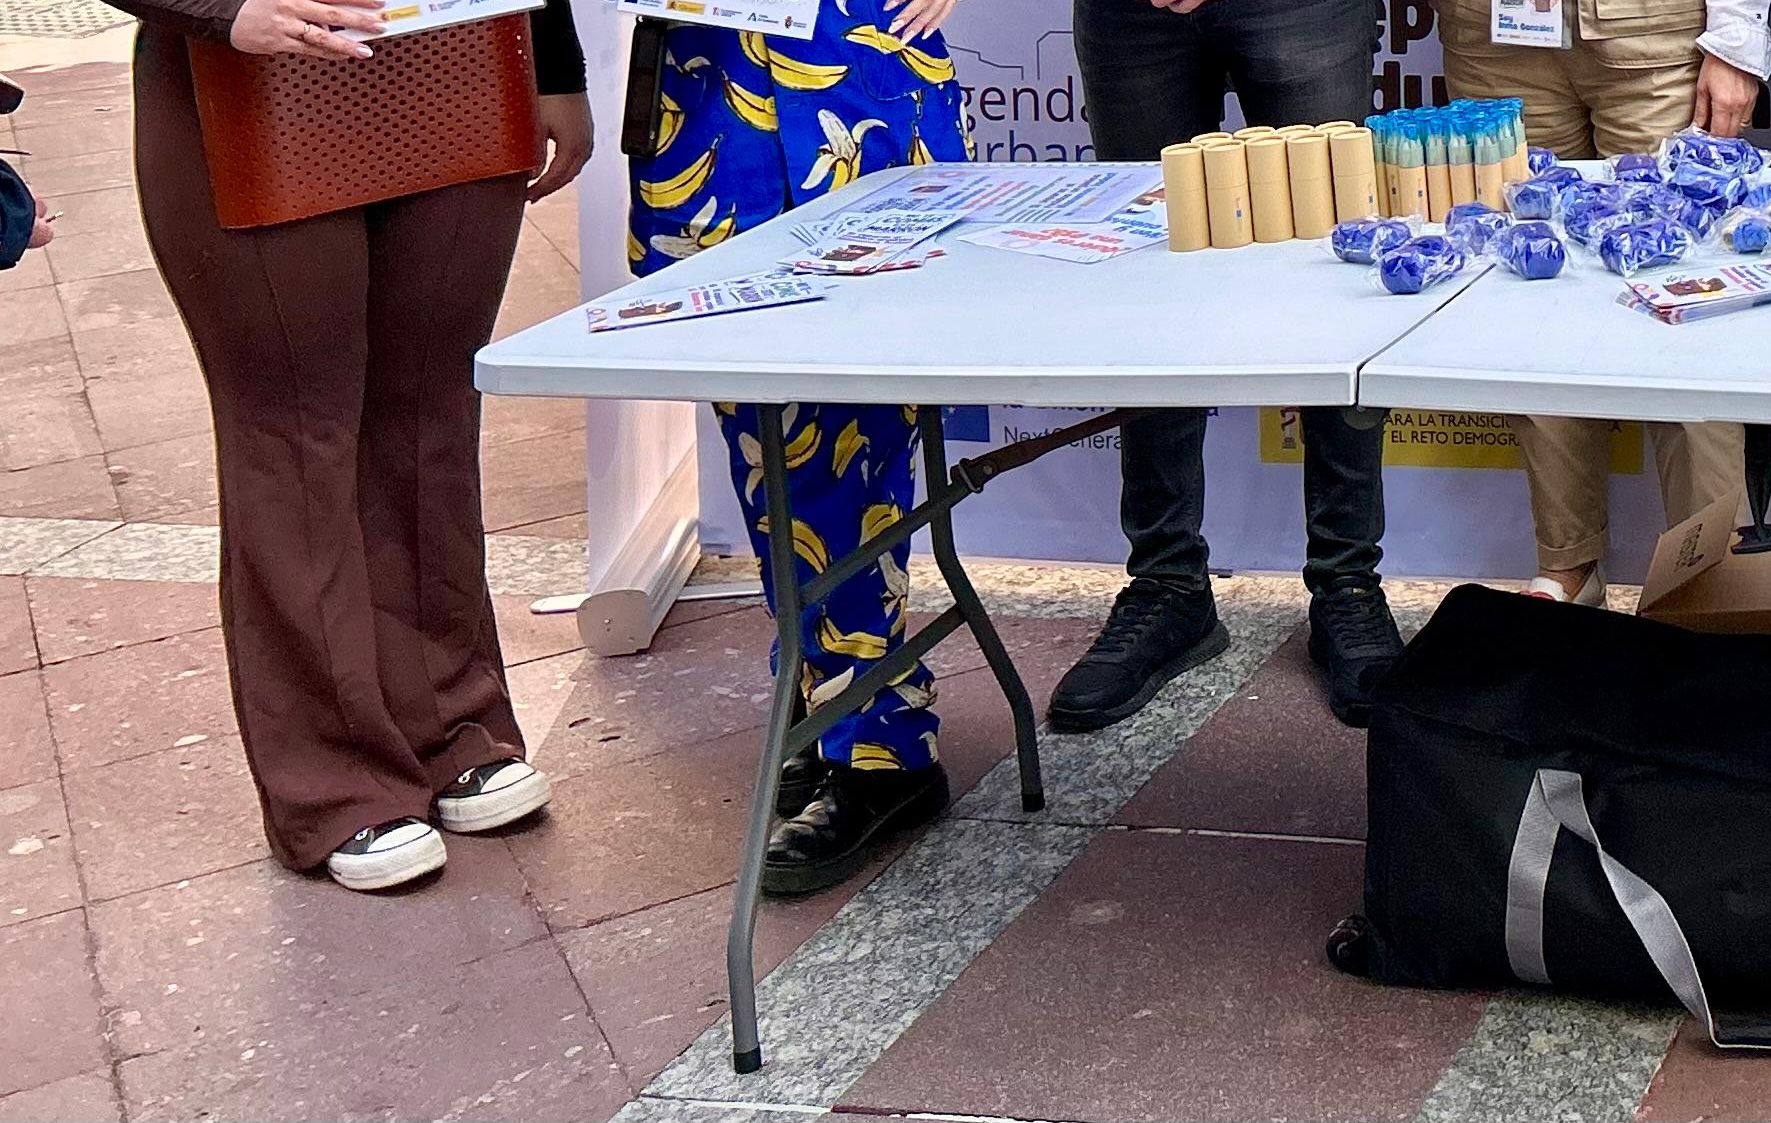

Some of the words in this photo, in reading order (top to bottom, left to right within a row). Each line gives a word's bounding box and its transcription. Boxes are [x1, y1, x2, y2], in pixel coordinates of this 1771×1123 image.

[1418, 415, 1436, 428] LA
[1437, 415, 1511, 429] TRANSICI
[1391, 431, 1407, 443] EL
[1411, 431, 1449, 445] RETO
[1452, 432, 1519, 446] DEMOGR
